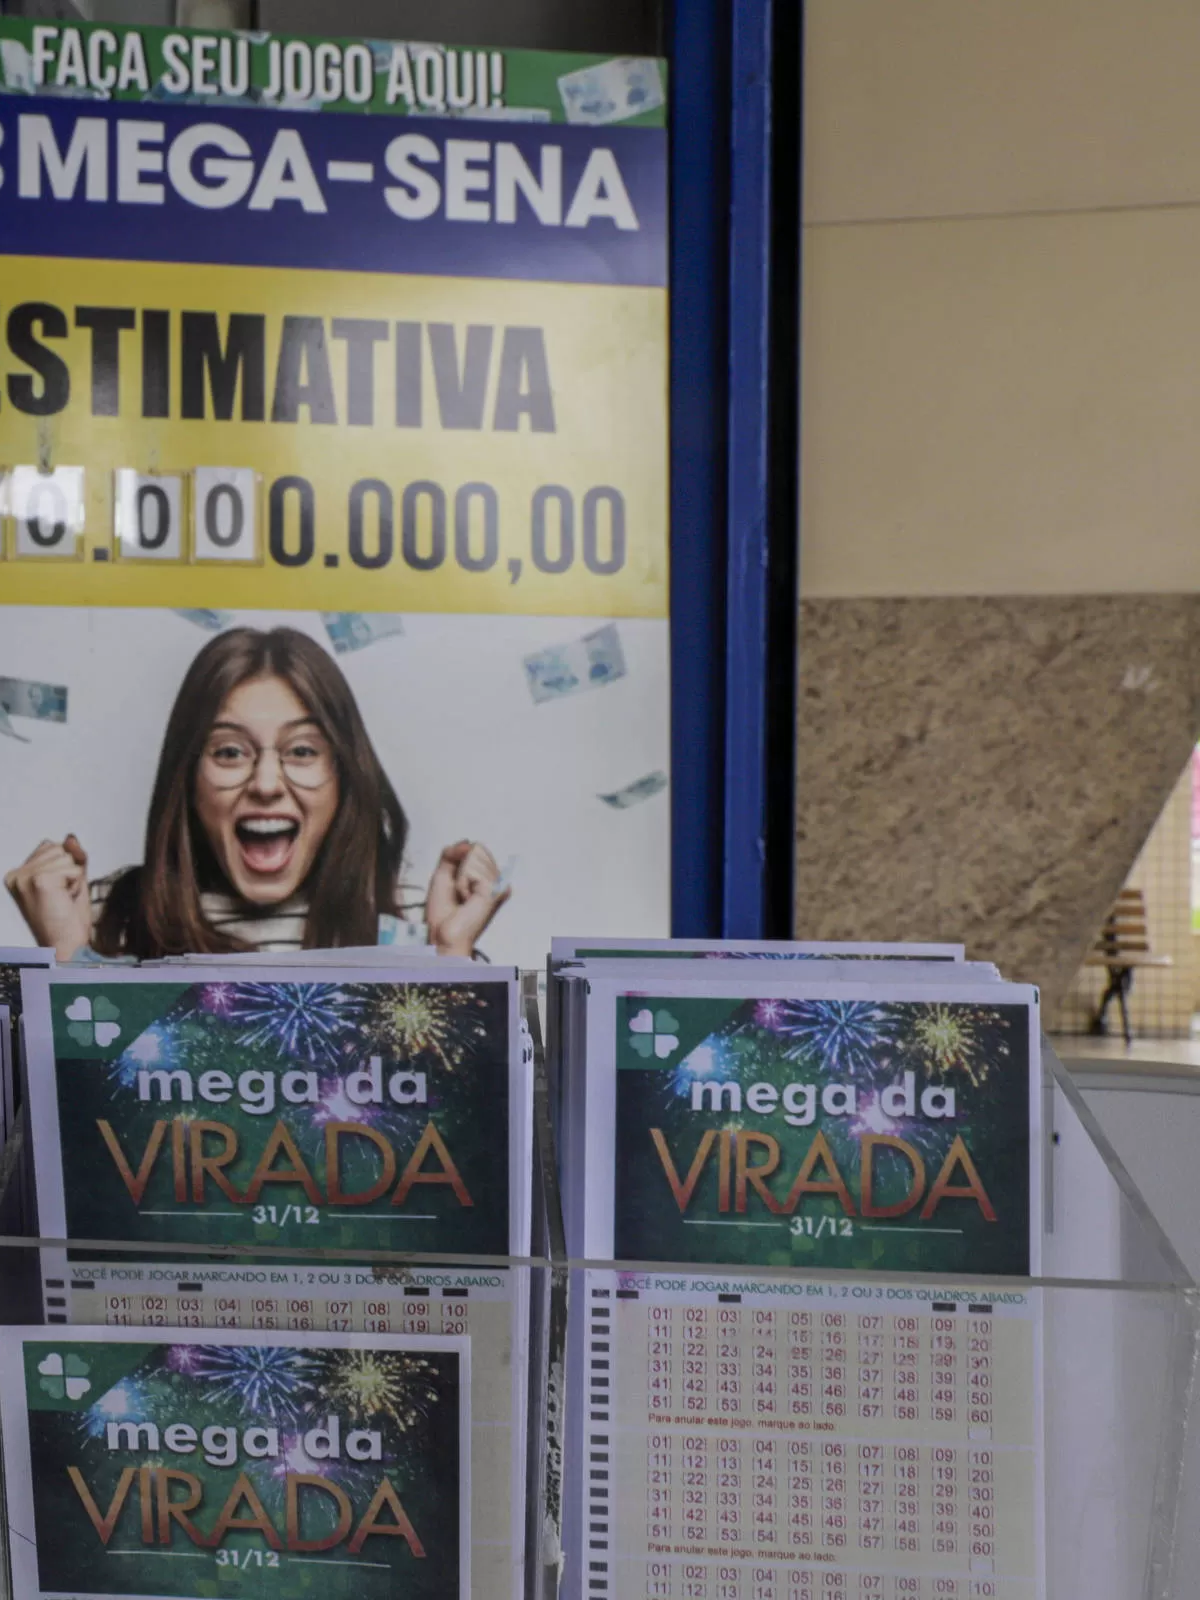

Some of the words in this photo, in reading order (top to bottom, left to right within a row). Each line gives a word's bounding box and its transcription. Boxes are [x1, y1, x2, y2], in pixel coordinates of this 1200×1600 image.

[32, 26, 149, 100] FAÇA
[161, 37, 249, 97] SEU
[262, 39, 372, 104] JOGO
[386, 45, 505, 109] AQUI!
[18, 115, 639, 230] MEGA-SENA
[138, 1067, 318, 1113] mega
[346, 1056, 427, 1105] da
[690, 1079, 855, 1125] mega
[880, 1071, 956, 1118] da
[96, 1119, 474, 1207] VIRADA
[649, 1127, 998, 1222] VIRADA
[252, 1204, 320, 1226] 31/12
[789, 1216, 853, 1238] 31/12
[72, 1268, 107, 1280] VOCÊ
[111, 1269, 144, 1280] PODE
[149, 1271, 188, 1281] JOGAR
[192, 1271, 266, 1282] MARCANDO
[271, 1272, 288, 1283] EM
[307, 1274, 314, 1284] 2
[319, 1274, 339, 1284] OU
[344, 1274, 350, 1284] 3
[355, 1275, 383, 1285] DOS
[455, 1276, 504, 1288] ABAIXO:
[619, 1277, 650, 1289] VOCÊ
[655, 1279, 686, 1290] PODE
[690, 1280, 729, 1292] JOGAR
[732, 1282, 802, 1294] MARCANDO
[806, 1285, 824, 1295] EM
[842, 1287, 848, 1297] 2
[852, 1287, 872, 1298] OU
[876, 1288, 883, 1298] 3
[887, 1289, 913, 1300] DOS
[916, 1290, 978, 1302] QUADROS
[982, 1293, 1027, 1305] ABAIXO:
[106, 1418, 278, 1464] mega
[304, 1415, 382, 1462] da
[648, 1414, 671, 1423] Para
[675, 1415, 704, 1424] anular
[708, 1417, 728, 1426] este
[758, 1420, 795, 1431] marque
[798, 1422, 810, 1430] ao
[67, 1466, 427, 1558] VIRADA
[215, 1547, 280, 1569] 31/12
